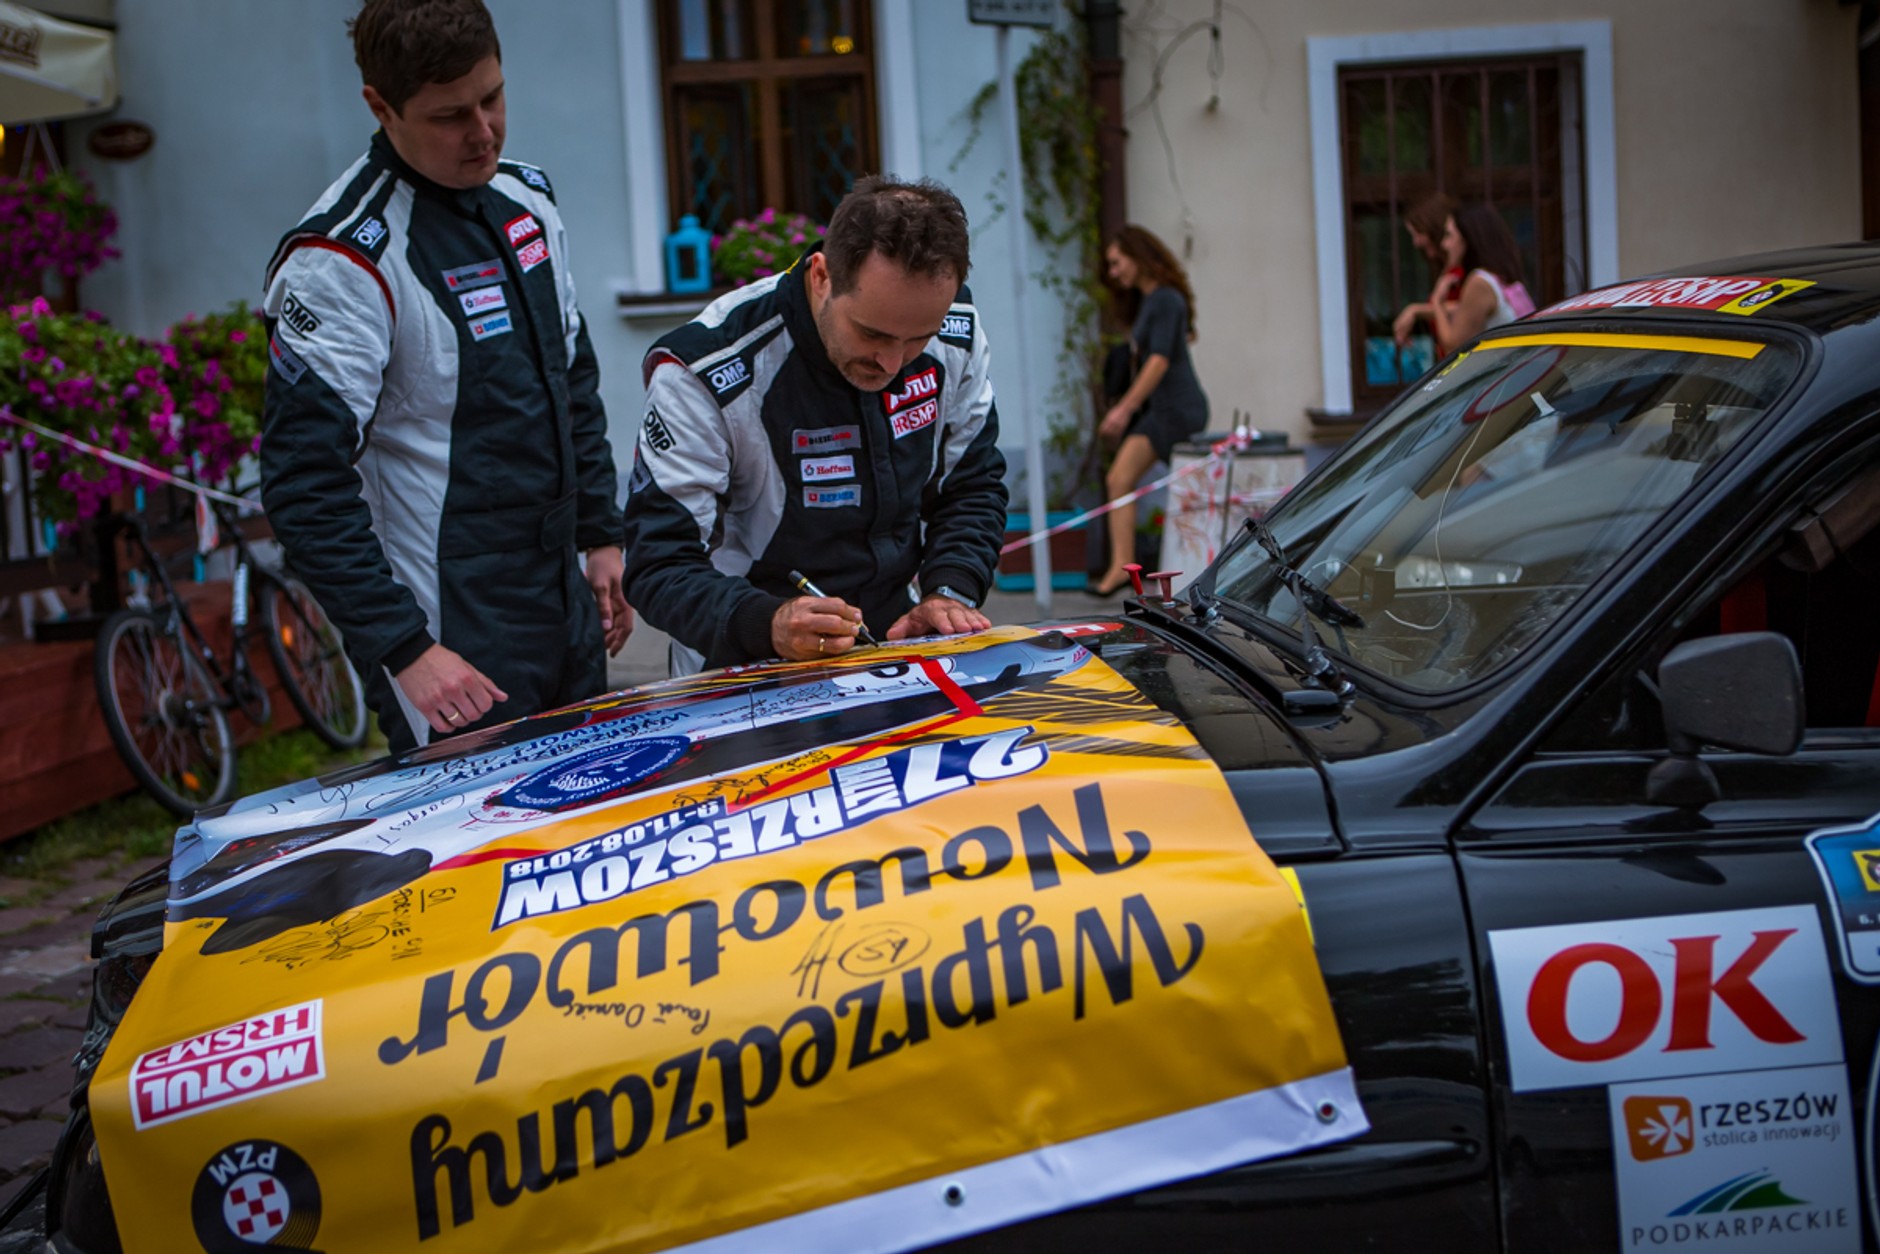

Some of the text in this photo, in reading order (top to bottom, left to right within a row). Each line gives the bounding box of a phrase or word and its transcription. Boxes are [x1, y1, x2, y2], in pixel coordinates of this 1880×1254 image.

[357, 219, 382, 246] OMP
[282, 297, 318, 334] OMP
[711, 362, 746, 389] OMP
[644, 410, 671, 452] OMP
[893, 402, 935, 436] HRSMP
[903, 726, 1048, 804] 27
[498, 786, 844, 927] RZESZOW
[378, 781, 1152, 1085] Nowotwór
[1526, 928, 1808, 1063] OK
[141, 1040, 310, 1115] MOTUL
[408, 892, 1205, 1243] Wyprzedzamy
[1700, 1092, 1838, 1129] rzeszów
[1704, 1121, 1841, 1148] stolica innowacji
[208, 1144, 278, 1187] PZM
[1632, 1208, 1849, 1246] PODKARPACKIE
